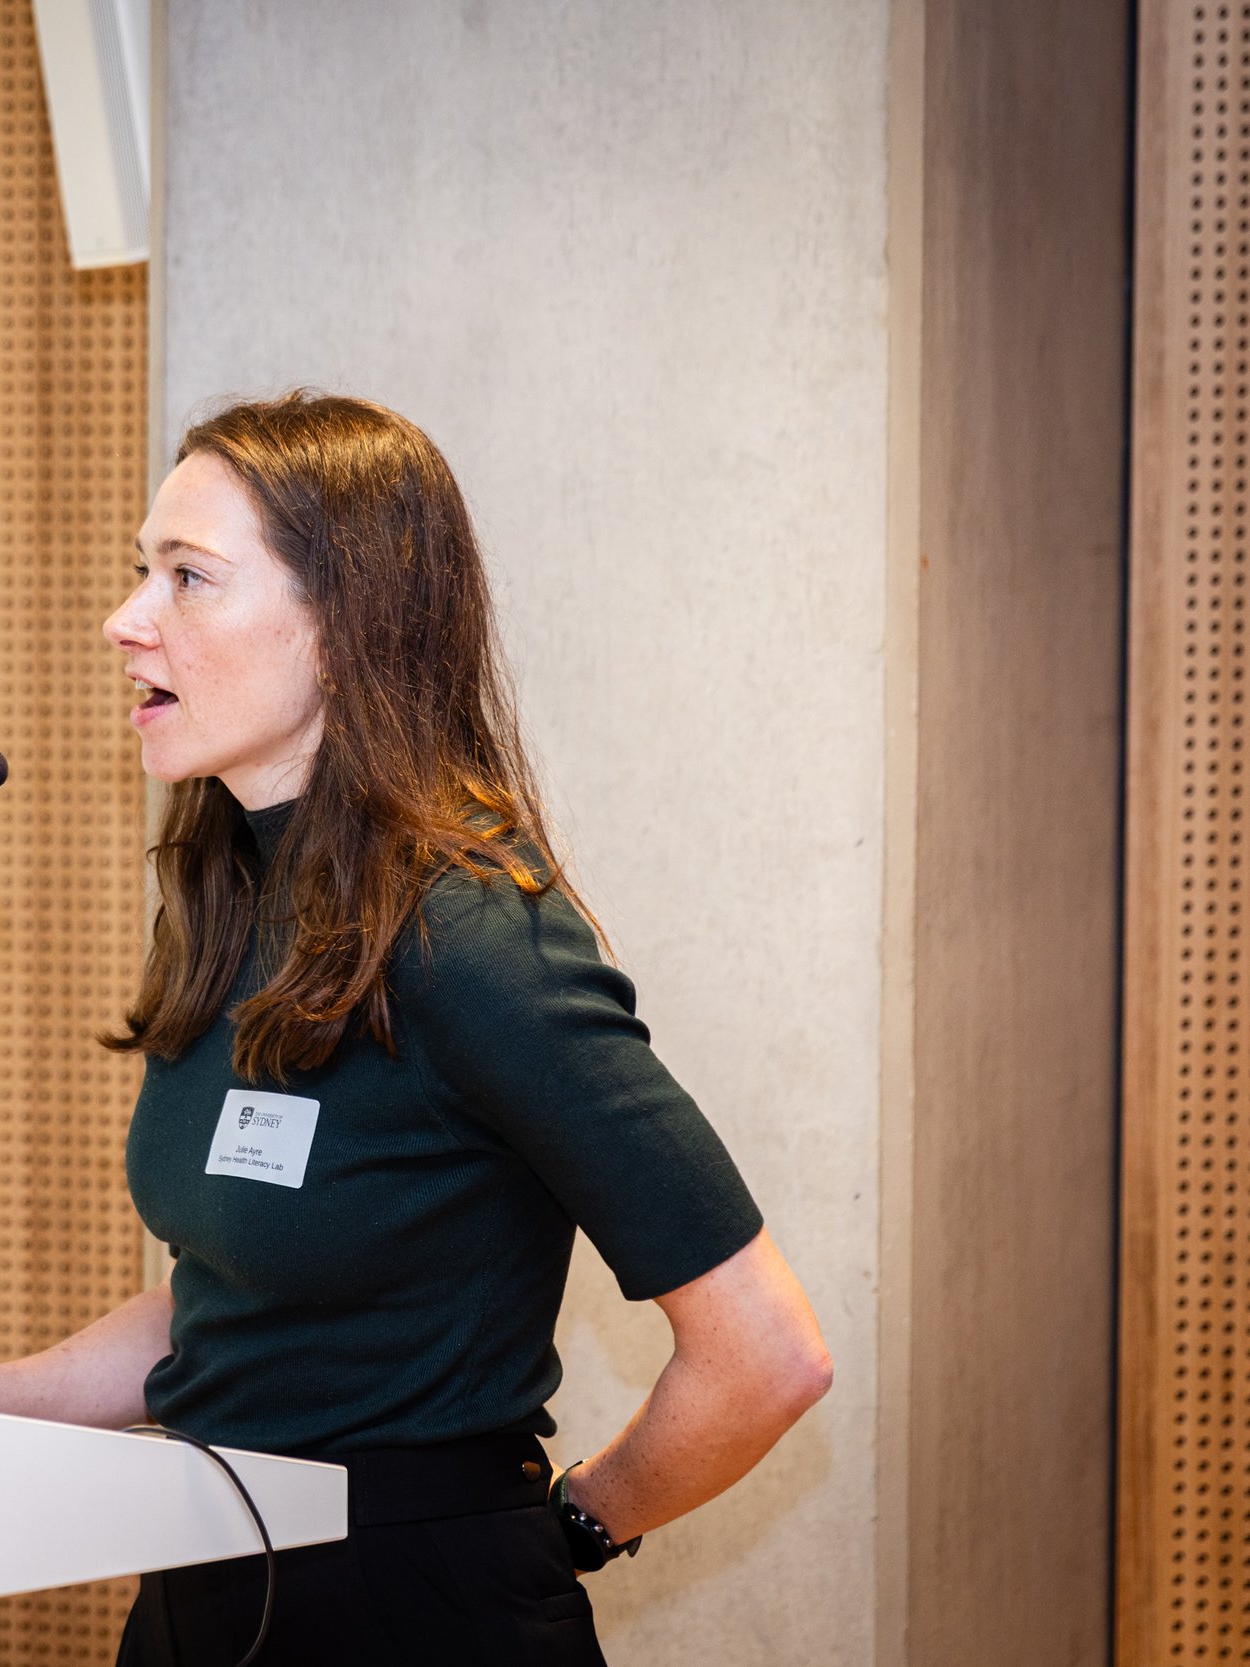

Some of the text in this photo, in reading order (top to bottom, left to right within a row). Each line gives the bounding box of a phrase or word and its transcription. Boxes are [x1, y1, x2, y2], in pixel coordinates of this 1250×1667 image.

[251, 1116, 282, 1129] SYDNEY
[248, 1146, 263, 1157] Ayre
[248, 1158, 271, 1170] Literacy
[271, 1161, 284, 1171] Lab
